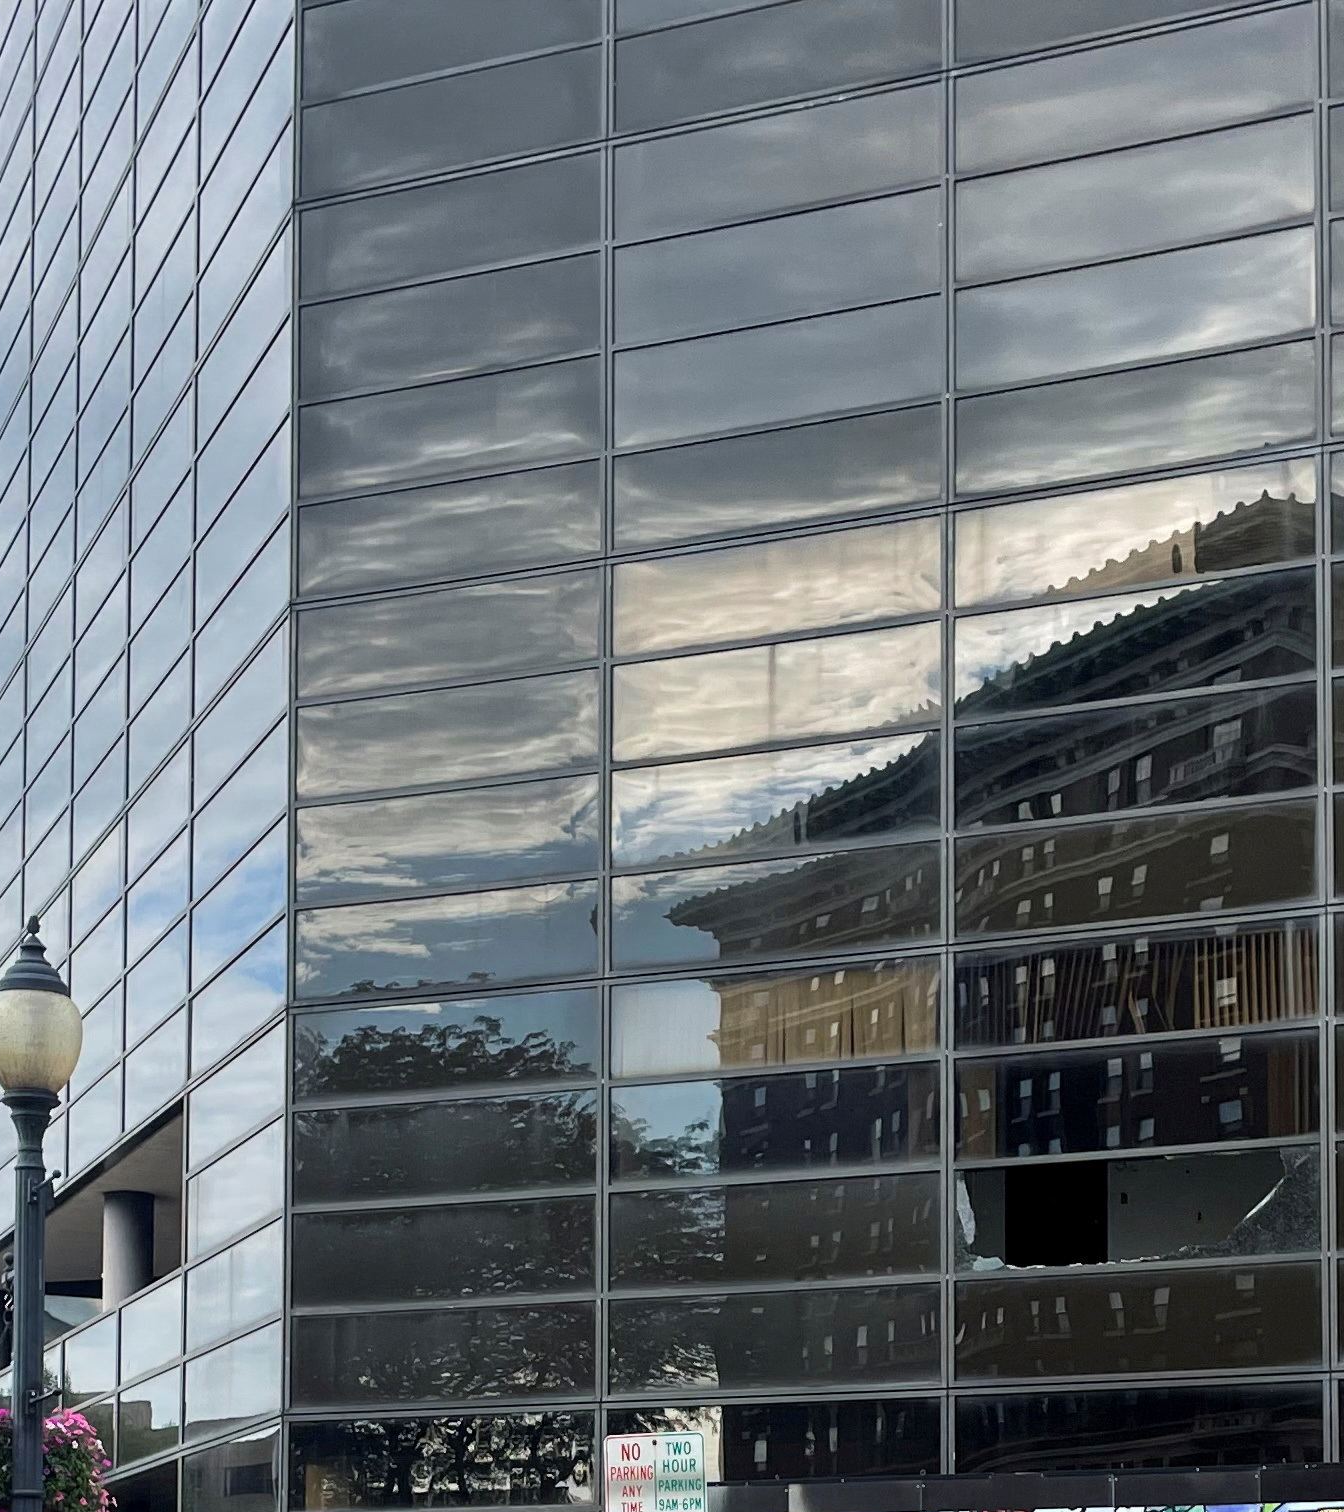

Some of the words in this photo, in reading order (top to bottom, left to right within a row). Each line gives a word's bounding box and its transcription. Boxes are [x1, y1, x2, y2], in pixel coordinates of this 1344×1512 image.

[621, 1443, 641, 1461] NO
[665, 1441, 691, 1455] TWO
[662, 1458, 696, 1473] HOUR
[610, 1465, 654, 1481] PARKING
[622, 1485, 642, 1497] ANY
[658, 1479, 702, 1492] PARKING
[659, 1498, 702, 1511] 9AM-6PM
